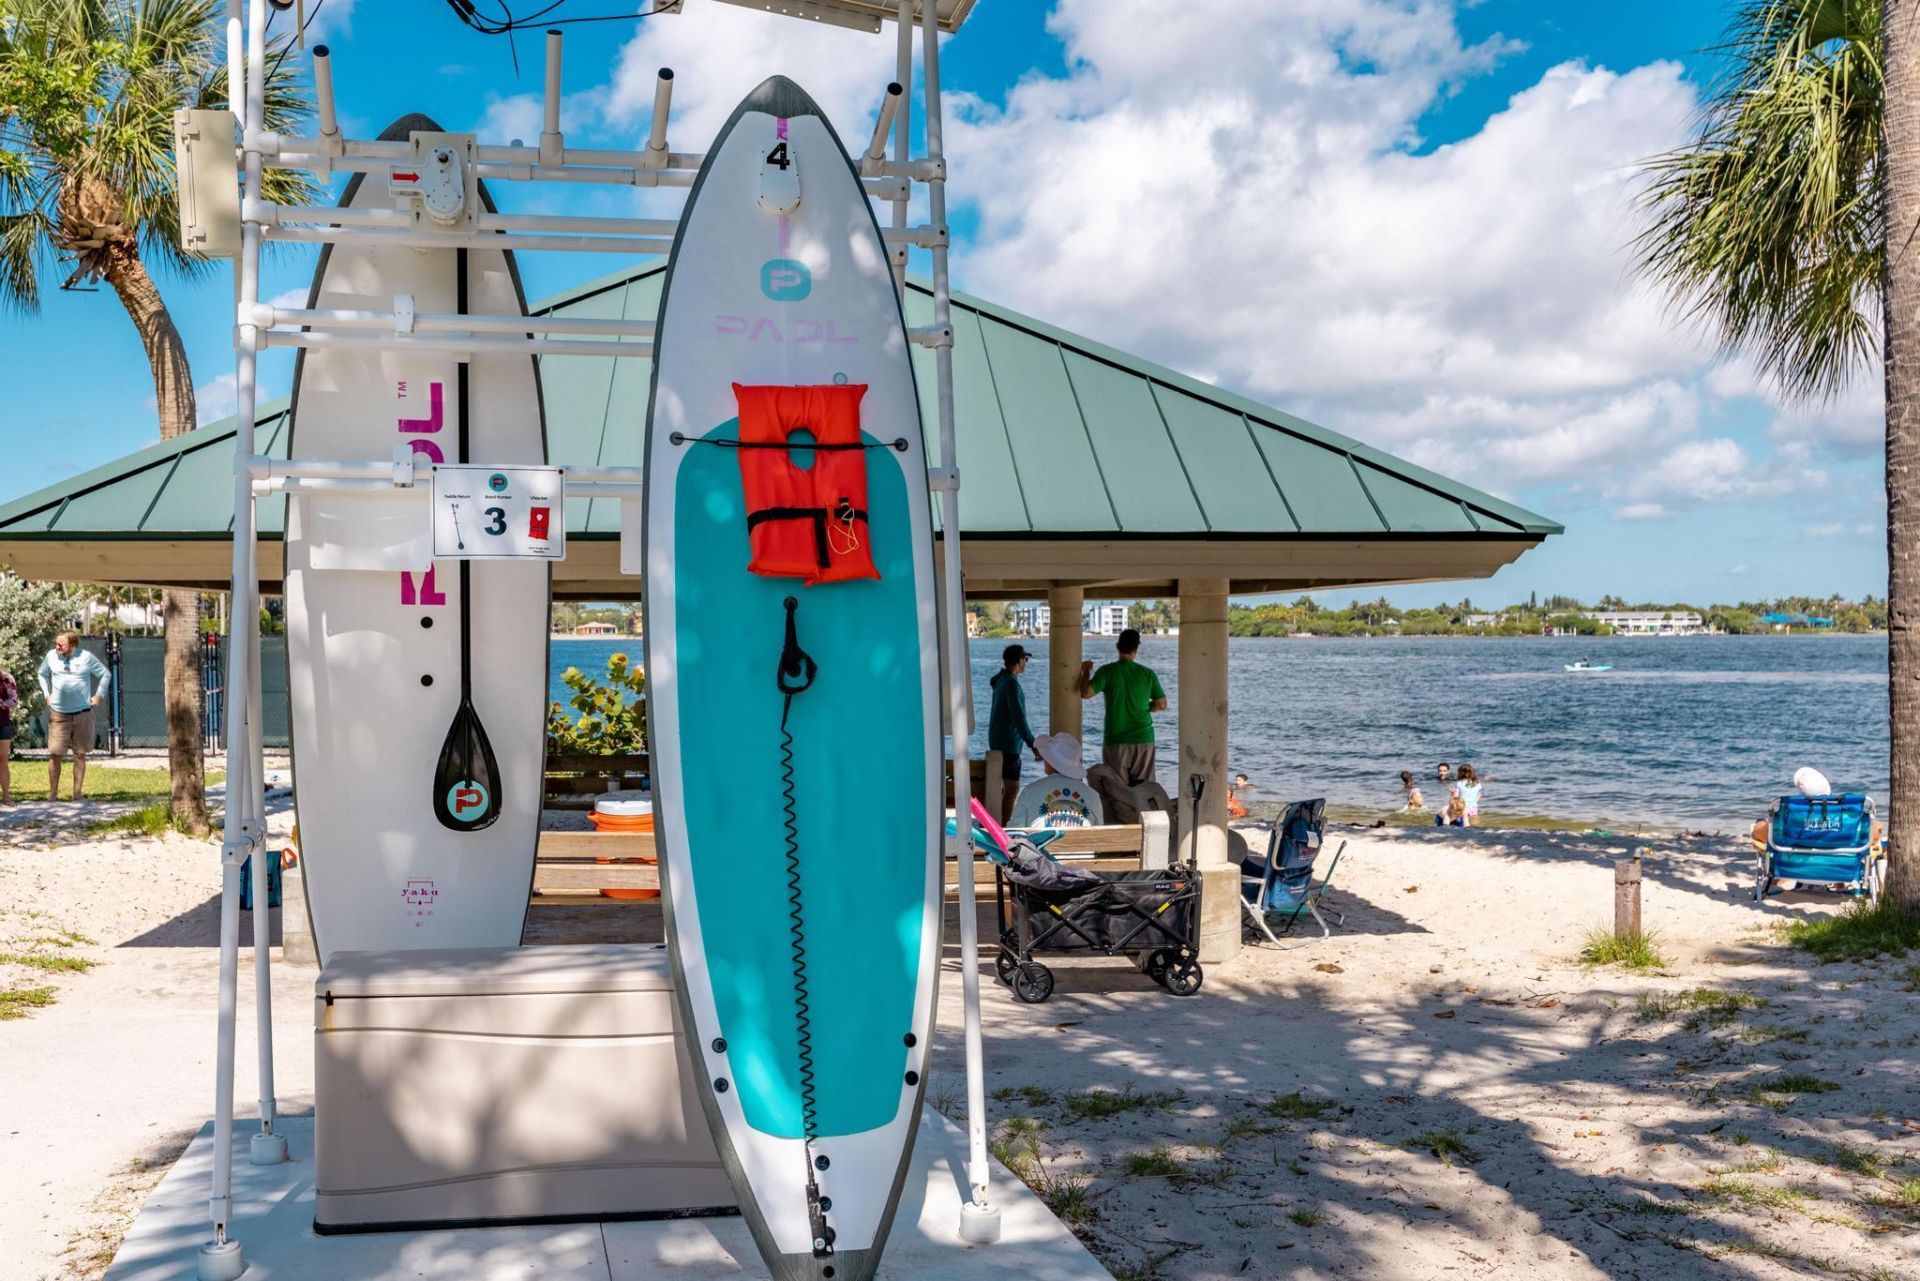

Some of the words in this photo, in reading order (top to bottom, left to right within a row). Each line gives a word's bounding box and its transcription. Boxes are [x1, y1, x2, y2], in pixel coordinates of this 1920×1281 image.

[766, 142, 790, 170] 4
[715, 315, 859, 344] PADL
[484, 507, 507, 536] 3
